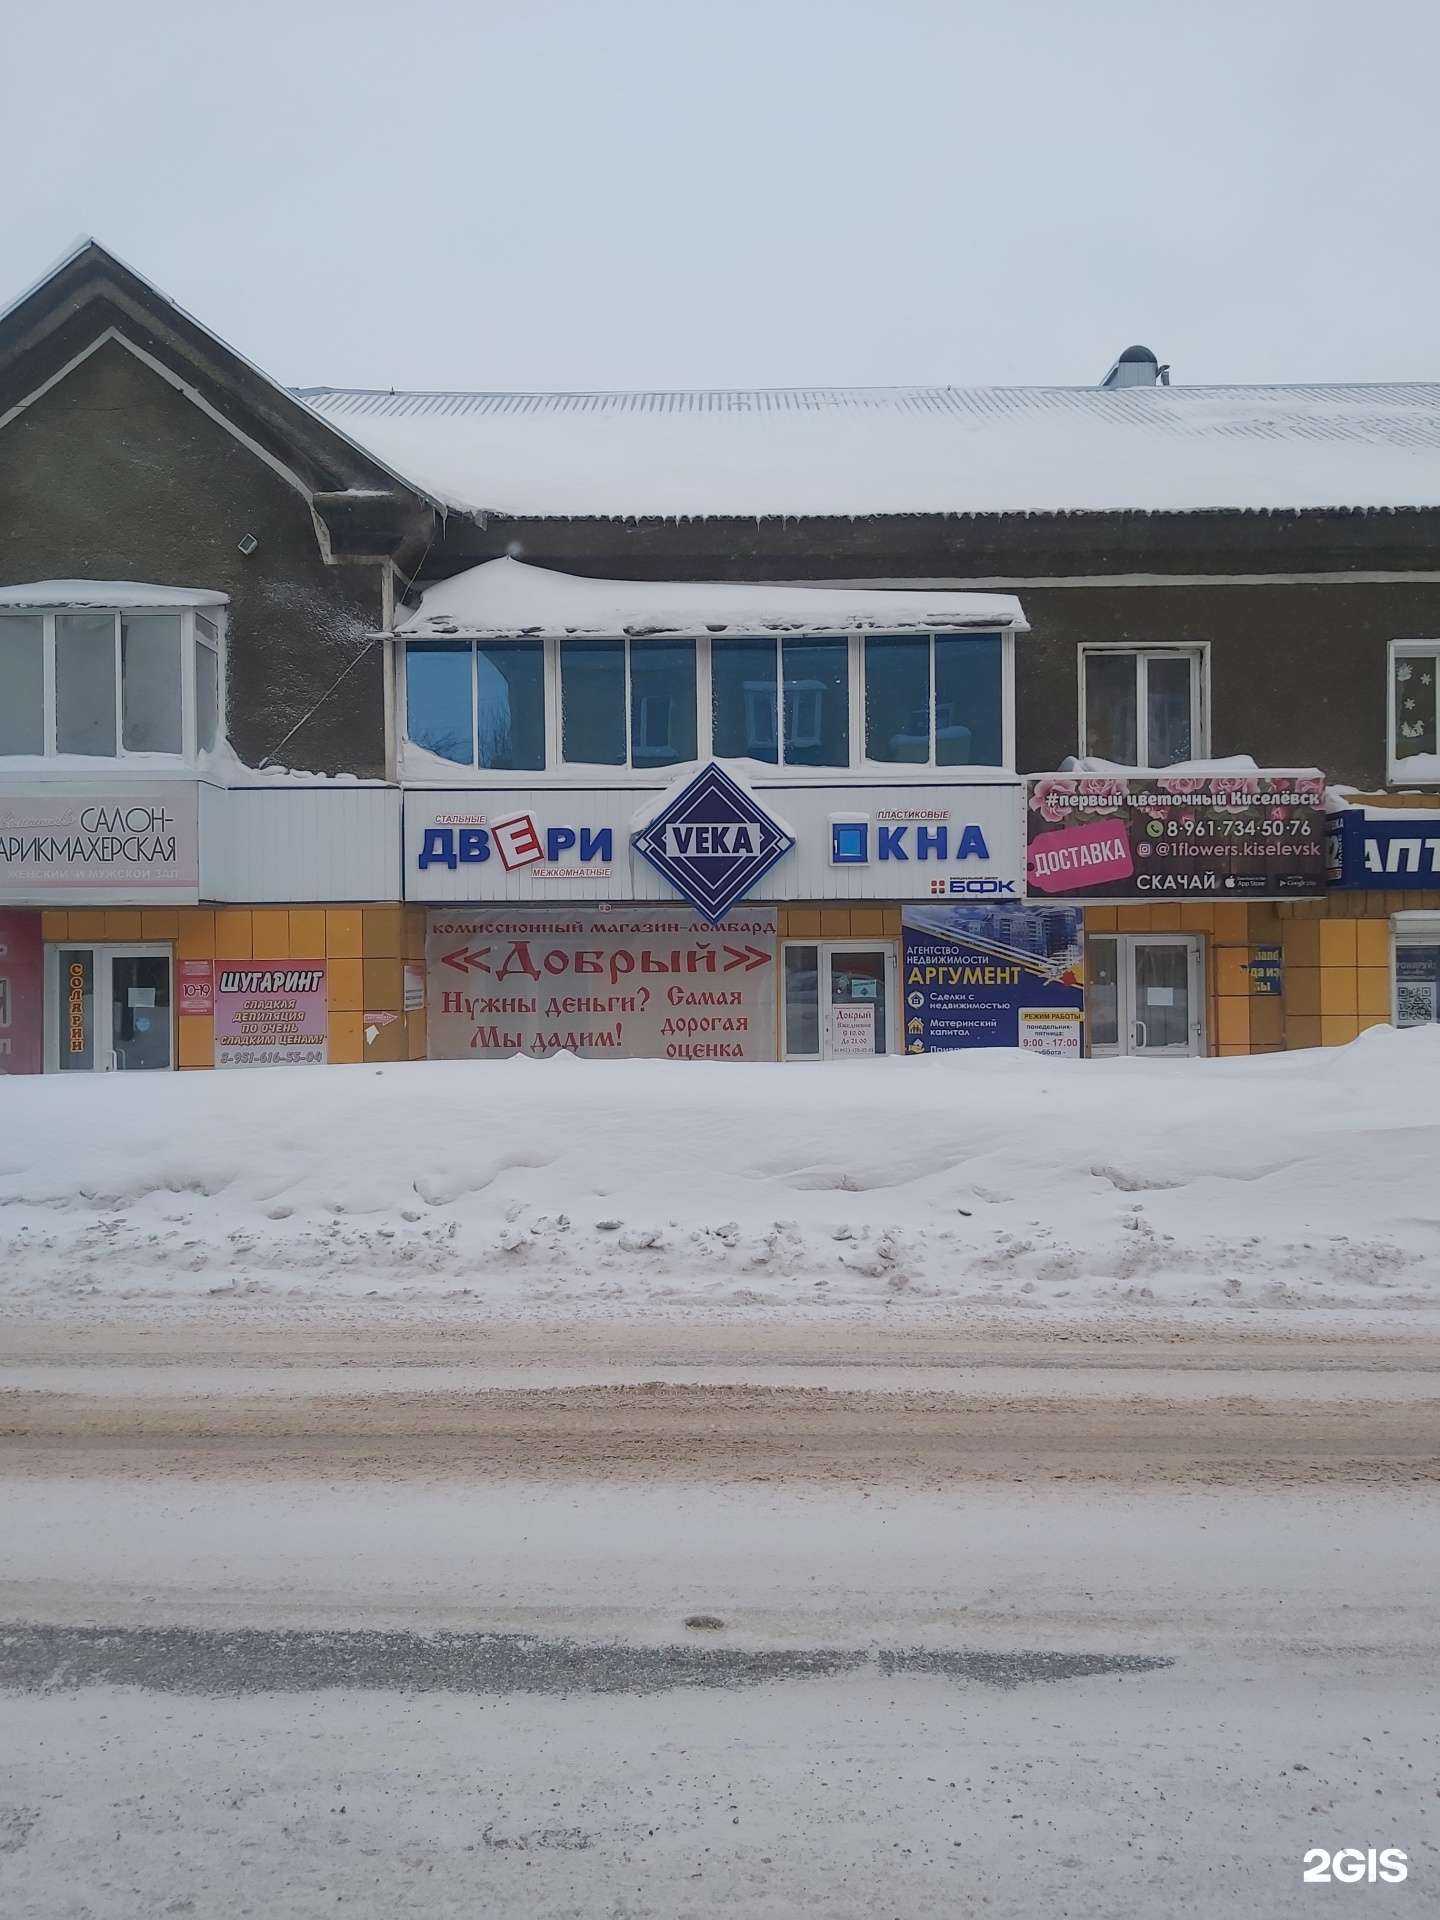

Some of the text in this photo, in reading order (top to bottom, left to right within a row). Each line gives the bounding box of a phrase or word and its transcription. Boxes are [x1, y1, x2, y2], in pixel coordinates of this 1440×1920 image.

[1045, 790, 1320, 811] #первый цветочный Киселёвск
[80, 807, 174, 833] САЛОН-
[434, 814, 487, 824] СТАЛЬНЫЕ
[877, 810, 949, 819] ПЛАСТИКОВЫЕ
[417, 814, 613, 872] ДВЕРИ
[673, 826, 753, 854] VEKA
[1155, 841, 1321, 857] @1flowers.kiselevsk
[1034, 838, 1127, 878] ДОСТАВКА
[532, 868, 612, 879] МЕЖКОМНАТНЫЕ
[1136, 871, 1217, 890] СКАЧАЙ
[432, 920, 776, 936] комиссионный магазин-ломбард
[906, 945, 960, 955] АГЕНТСТВО
[906, 955, 990, 965] НЕДВИЖИМОСТИ
[219, 970, 324, 993] ШУГАРИНГ
[907, 966, 1022, 985] АРГУМЕНТ
[183, 983, 211, 998] 10-19
[667, 985, 742, 1006] Самая
[929, 991, 975, 1002] Сделки с
[440, 991, 537, 1021] Нужны
[544, 986, 651, 1018] деньги?
[929, 1001, 1011, 1010] недвижимостью
[232, 1011, 305, 1023] ДЕПИЛЯЦИЯ
[929, 1017, 997, 1028] Материнский
[1023, 1012, 1081, 1021] РЕЖИМ РАБОТЫ
[241, 1023, 299, 1033] ПО ОЧЕНЬ
[660, 1016, 749, 1037] дорогая
[929, 1029, 970, 1037] капитал
[279, 1034, 325, 1046] ЦЕНАМ!
[470, 1022, 623, 1053] Мы дадим!
[1022, 1038, 1044, 1048] 9:00
[1052, 1038, 1079, 1048] 17:00
[666, 1042, 744, 1060] оценка
